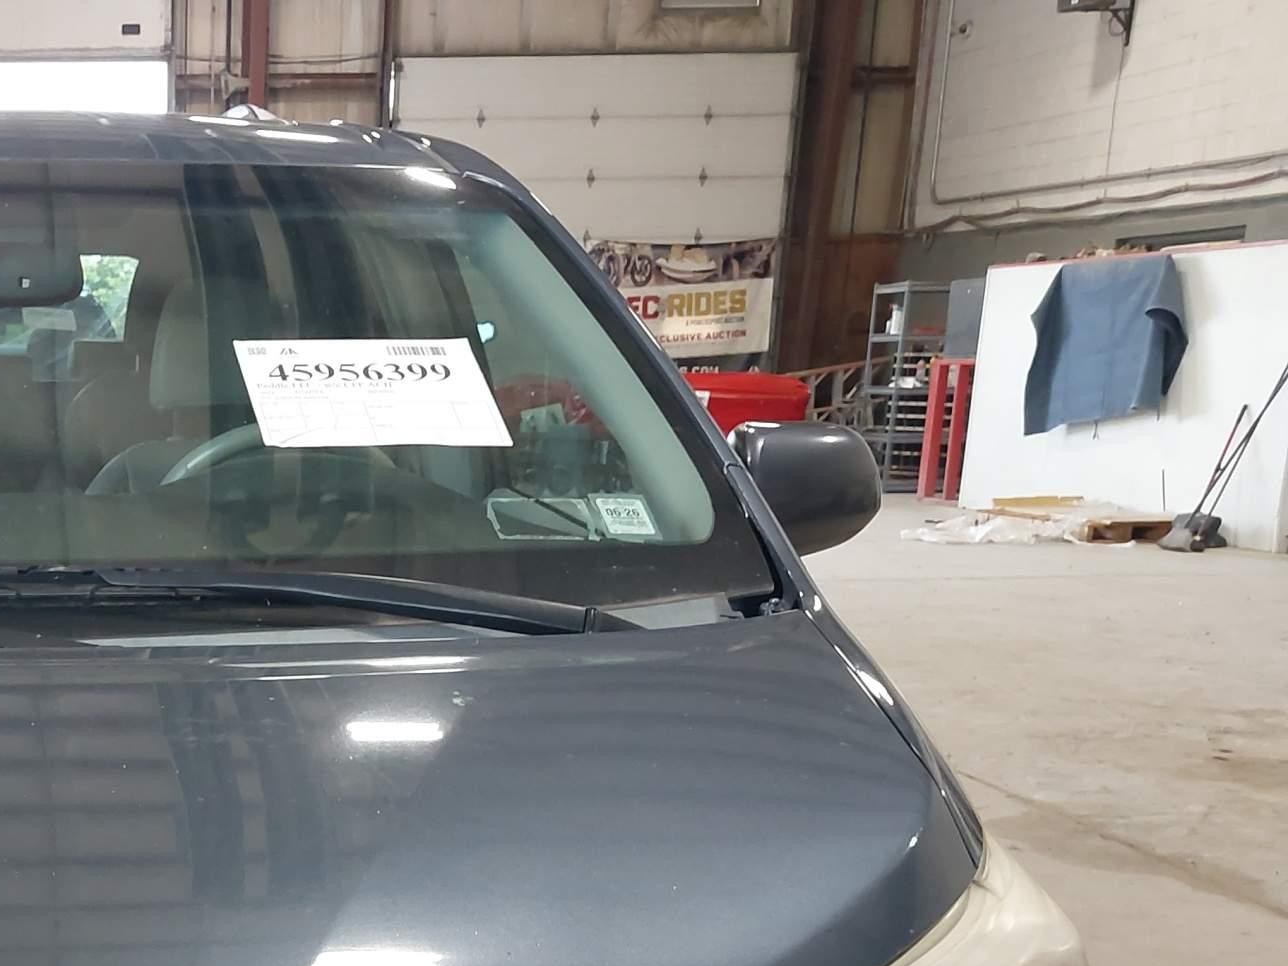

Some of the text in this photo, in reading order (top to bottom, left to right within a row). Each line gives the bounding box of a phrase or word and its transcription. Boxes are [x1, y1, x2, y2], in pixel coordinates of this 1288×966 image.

[666, 288, 747, 318] RIDES
[705, 329, 747, 341] AUCTION
[269, 363, 451, 382] 45956399
